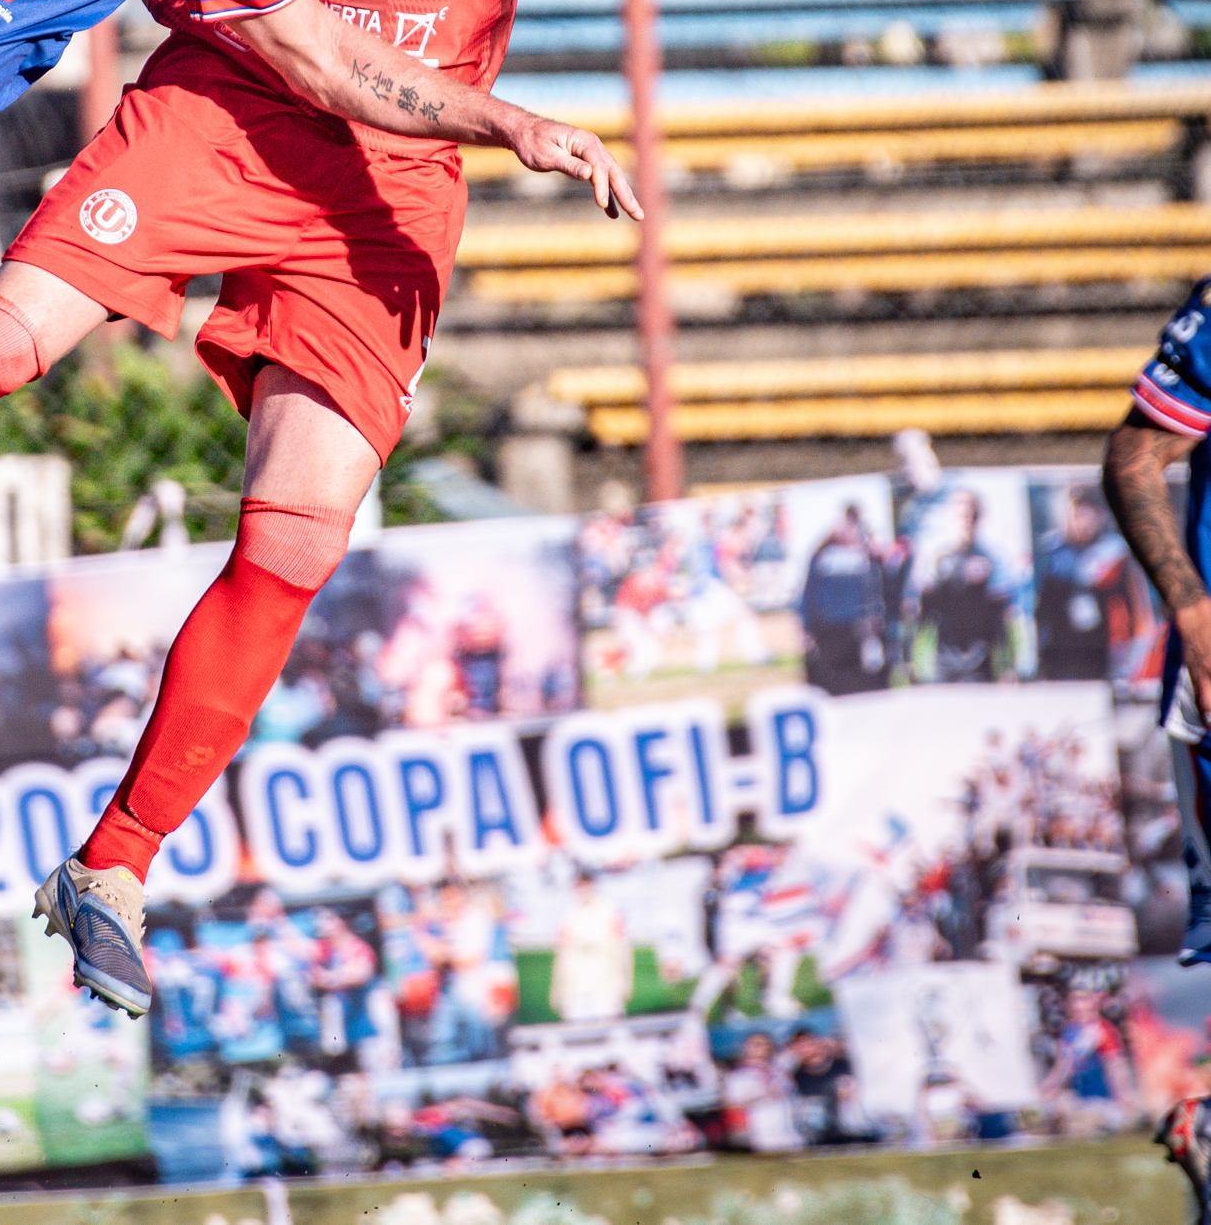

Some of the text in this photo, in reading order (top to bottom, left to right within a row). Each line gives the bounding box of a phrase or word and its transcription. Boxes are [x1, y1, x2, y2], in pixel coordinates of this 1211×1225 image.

[95, 198, 126, 229] U
[266, 750, 523, 867] COPA
[567, 709, 820, 838] OFI-B
